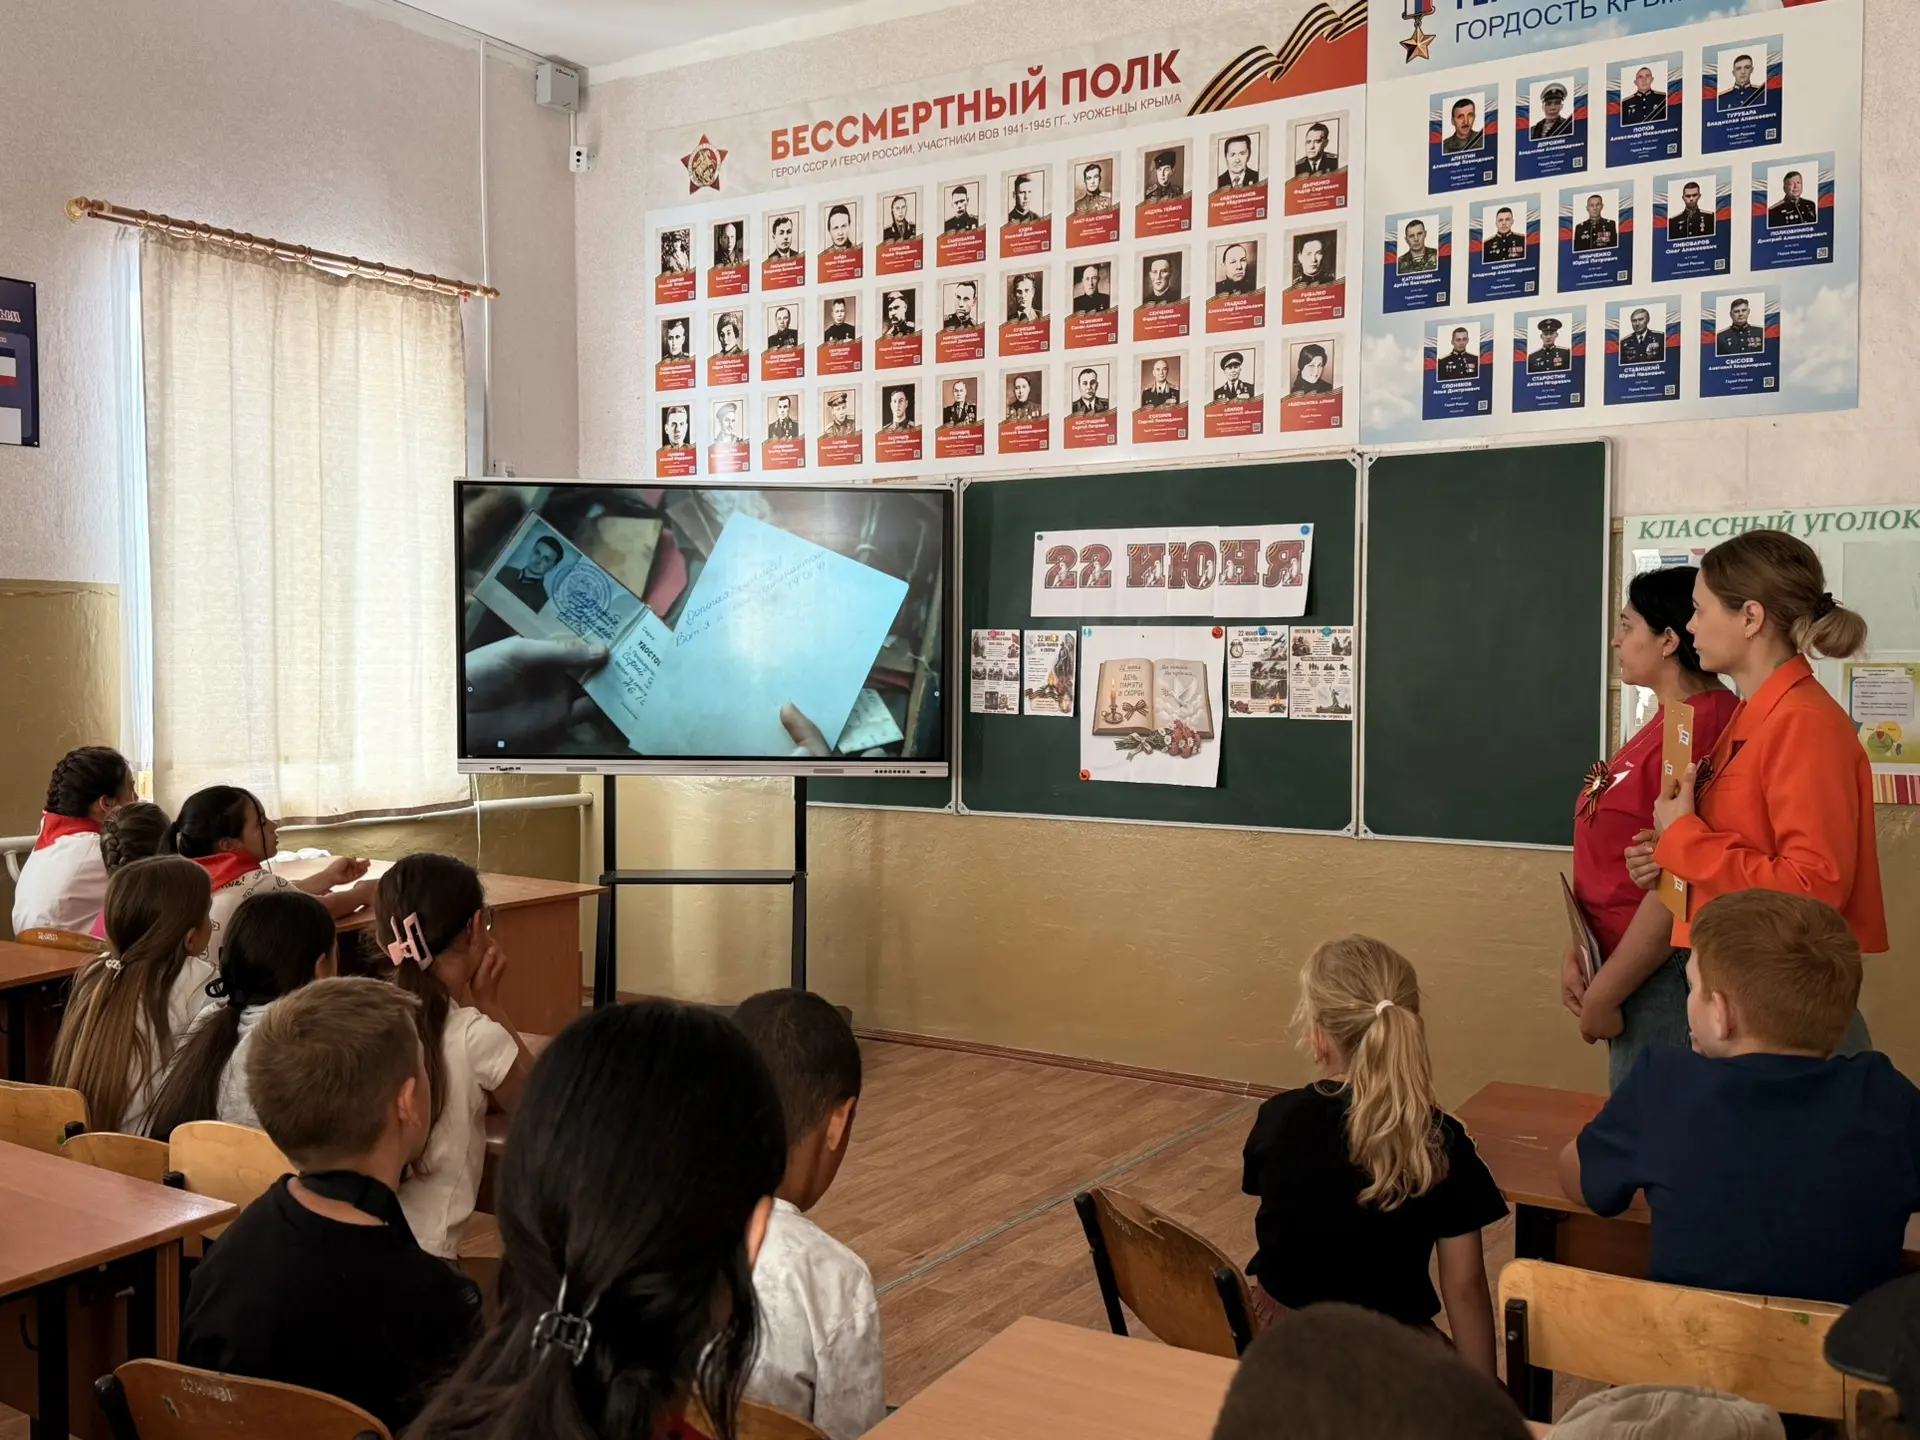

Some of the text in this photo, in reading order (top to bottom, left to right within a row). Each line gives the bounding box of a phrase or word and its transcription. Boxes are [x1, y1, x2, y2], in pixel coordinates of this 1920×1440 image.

[1455, 2, 1597, 43] ГОРДОСТЬ
[771, 49, 1181, 160] БЕССМЕРТНЫЙ ПОЛК
[1727, 110, 1756, 118] ТУРУБАРА
[1707, 112, 1776, 127] Владислав Алексеевич
[1633, 125, 1654, 133] ПОПОВ
[1643, 127, 1678, 136] Николаевич
[771, 165, 801, 179] ГЕРОИ
[802, 159, 828, 174] СССР
[830, 157, 837, 168] И
[839, 150, 870, 167] ГЕРОИ
[872, 143, 916, 160] РОССИИ,
[918, 132, 976, 153] УЧАСТНИКИ
[978, 128, 999, 141] ВОВ
[1003, 118, 1051, 137] 1941-1945
[1073, 101, 1137, 124] УРОЖЕНЦЫ
[1140, 93, 1182, 111] КРЫМА
[1538, 139, 1565, 148] ДОРОХИН
[1451, 153, 1476, 161] АПУХТИН
[1433, 161, 1460, 169] Александр
[1220, 191, 1256, 201] АБДУРАМАНОВ
[1163, 205, 1182, 213] ТЕЙФУК
[1770, 227, 1814, 236] ПОЛКОВНИКОВ
[1757, 232, 1827, 244] Дмитрий Александрович
[1673, 239, 1709, 248] ПИВОВАРОВ
[1666, 244, 1717, 255] Олег Алексеевич
[1572, 256, 1618, 266] Юрий Петрович
[1497, 266, 1535, 275] Александрович
[1402, 274, 1432, 282] КАТУНЬКИН
[1410, 278, 1441, 286] Викторович
[1624, 365, 1660, 373] СТАВИЦКИЙ
[1532, 374, 1566, 382] СТАРОСТИН
[1637, 370, 1665, 378] Иванович
[1448, 386, 1480, 394] Дмитриевич
[1638, 508, 1920, 540] КЛАССНЫЙ УГОЛОК
[1044, 539, 1305, 590] 22 ИЮНЯ
[686, 591, 729, 626] Дорогая
[676, 629, 699, 648] Вот
[638, 640, 662, 667] УДОСТО
